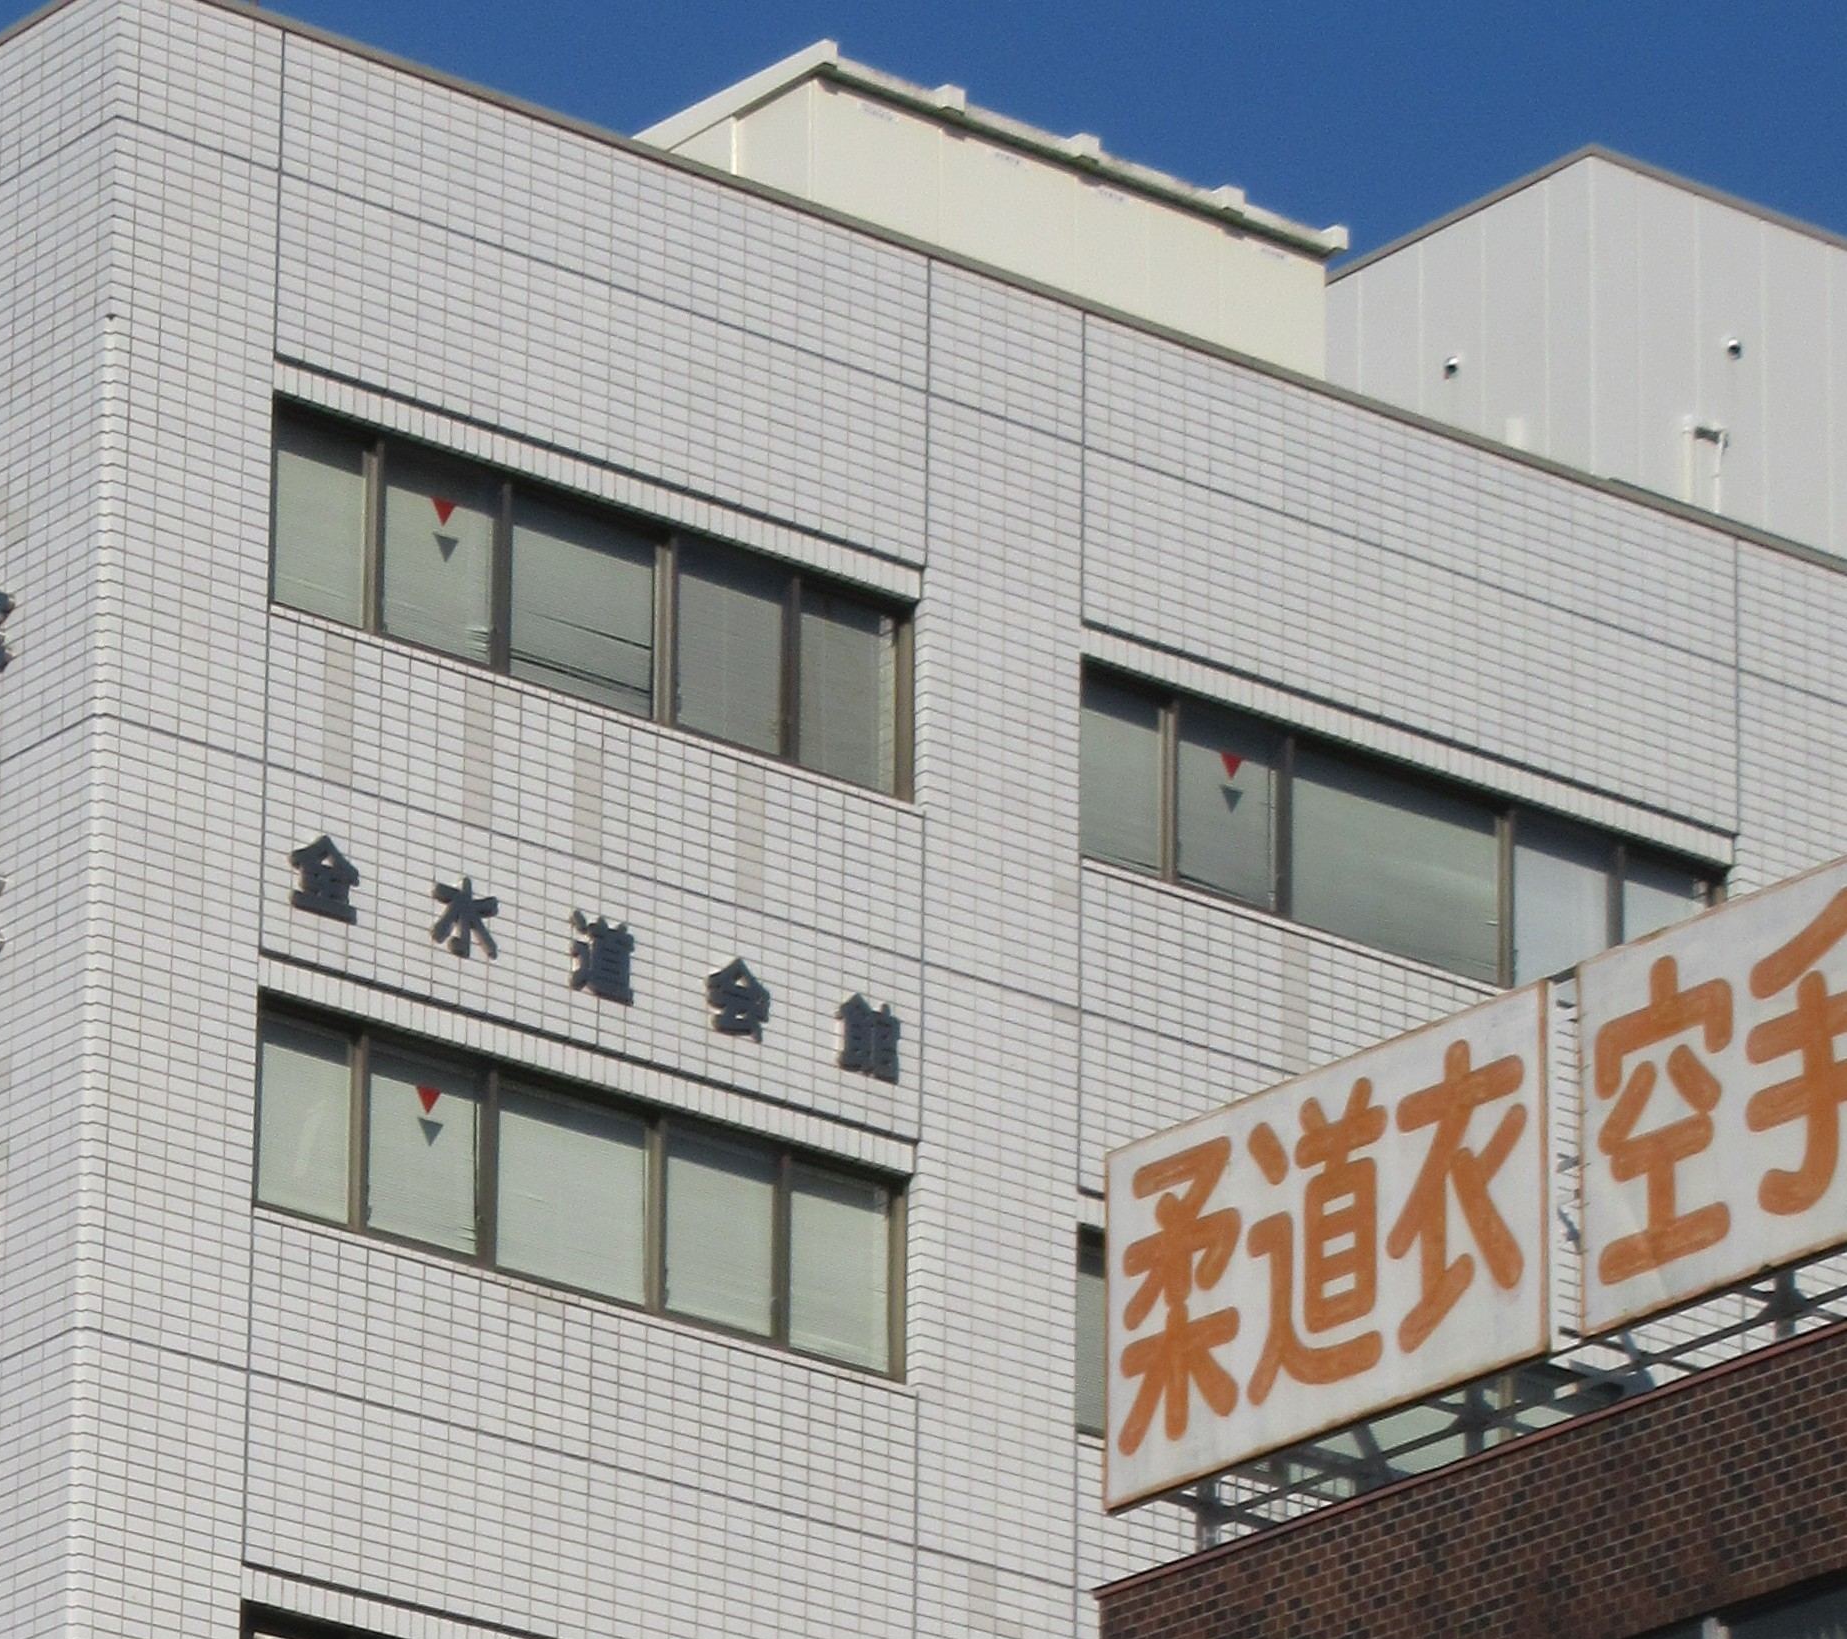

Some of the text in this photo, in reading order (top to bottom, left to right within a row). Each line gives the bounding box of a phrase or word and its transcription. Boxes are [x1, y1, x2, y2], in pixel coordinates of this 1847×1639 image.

[289, 835, 902, 1082] 全水道会館
[1594, 889, 1847, 1285] 空手
[1118, 1039, 1527, 1457] 柔道衣
